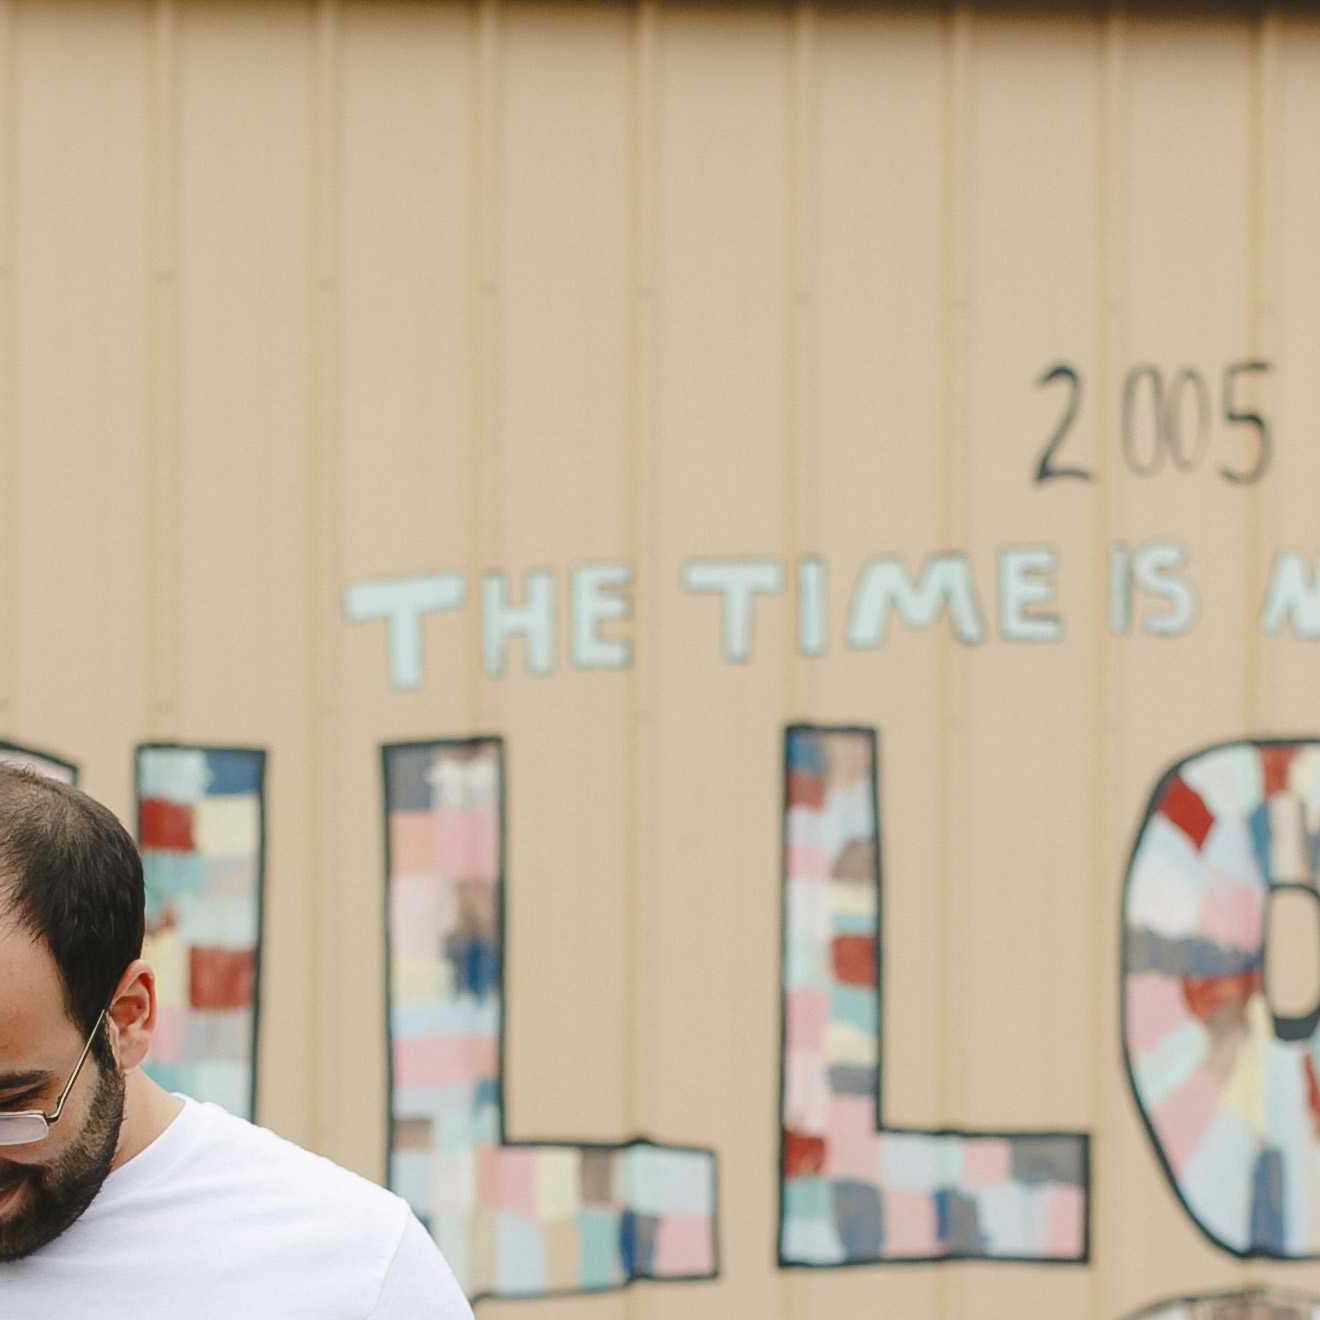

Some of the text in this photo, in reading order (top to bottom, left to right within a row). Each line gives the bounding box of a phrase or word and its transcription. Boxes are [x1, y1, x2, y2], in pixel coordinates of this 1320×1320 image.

[1033, 360, 1274, 486] 2005
[342, 561, 634, 690] THE
[680, 546, 1066, 663] TIME
[1107, 541, 1198, 638] IS
